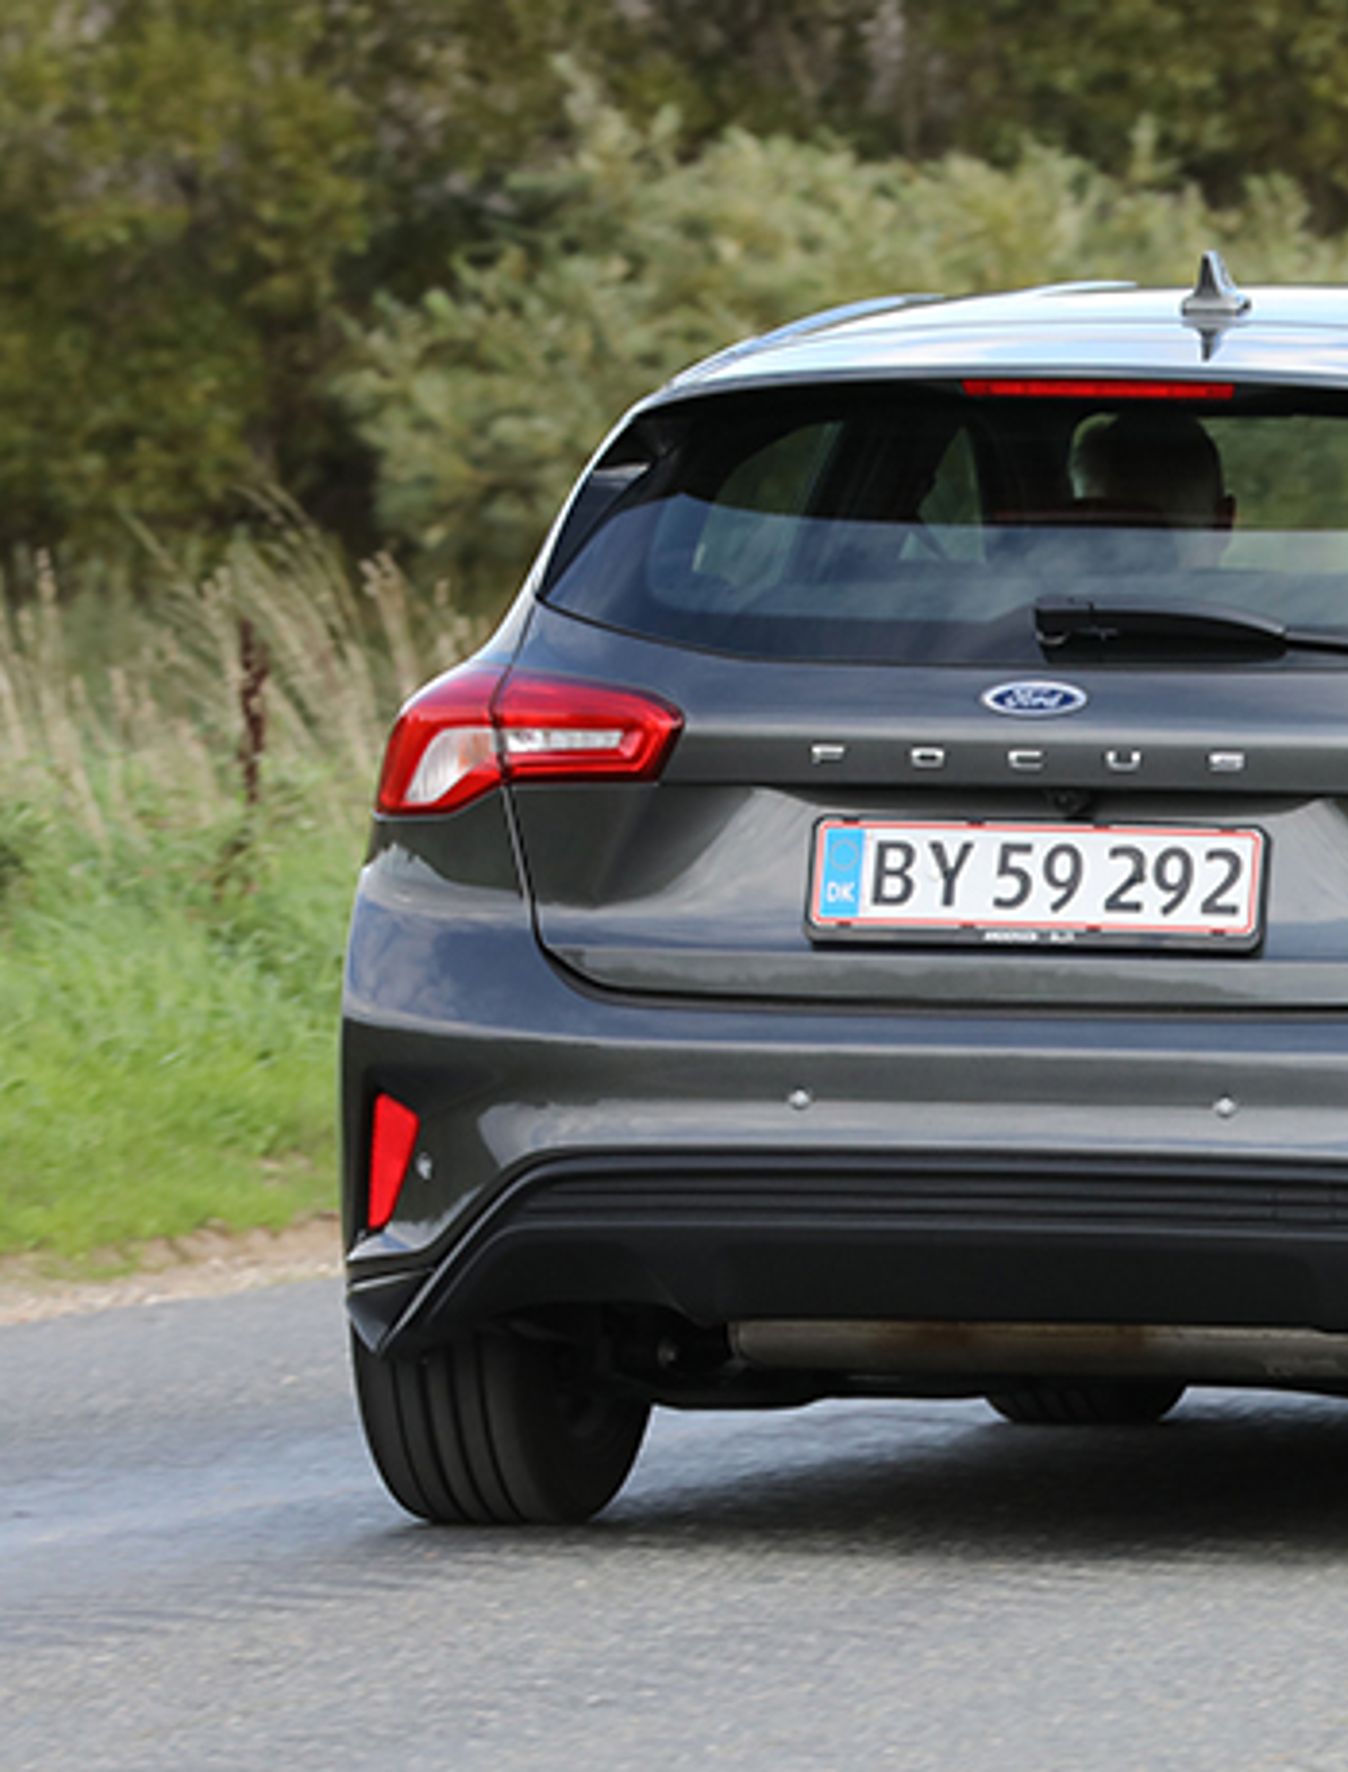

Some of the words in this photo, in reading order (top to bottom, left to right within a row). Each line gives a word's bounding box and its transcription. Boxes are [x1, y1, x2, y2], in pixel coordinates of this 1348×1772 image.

[1003, 685, 1064, 708] Ford
[811, 743, 1246, 773] FOCUS
[827, 881, 856, 902] DK
[869, 840, 975, 907] BY
[992, 843, 1084, 912] 59
[1103, 845, 1244, 917] 292
